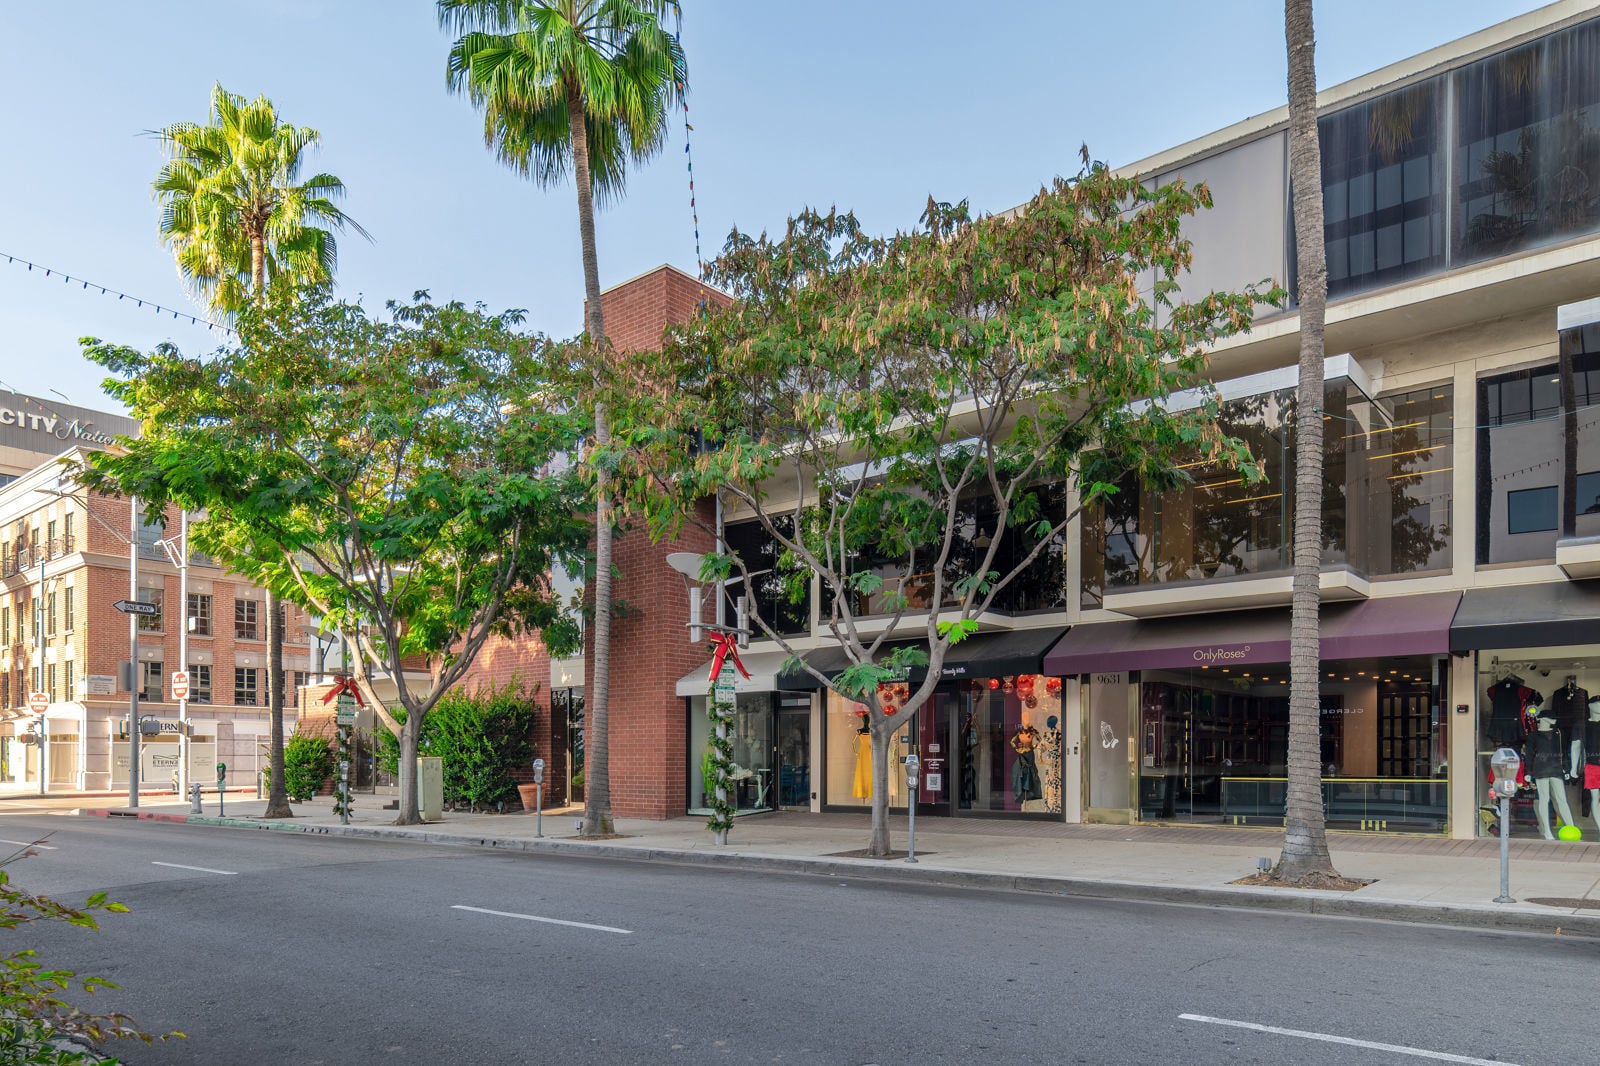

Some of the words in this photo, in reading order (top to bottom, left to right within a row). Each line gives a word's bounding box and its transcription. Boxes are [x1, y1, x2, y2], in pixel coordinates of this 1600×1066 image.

[0, 408, 57, 433] CITY
[1193, 648, 1246, 663] OnlyRoses
[1097, 674, 1121, 684] 9631
